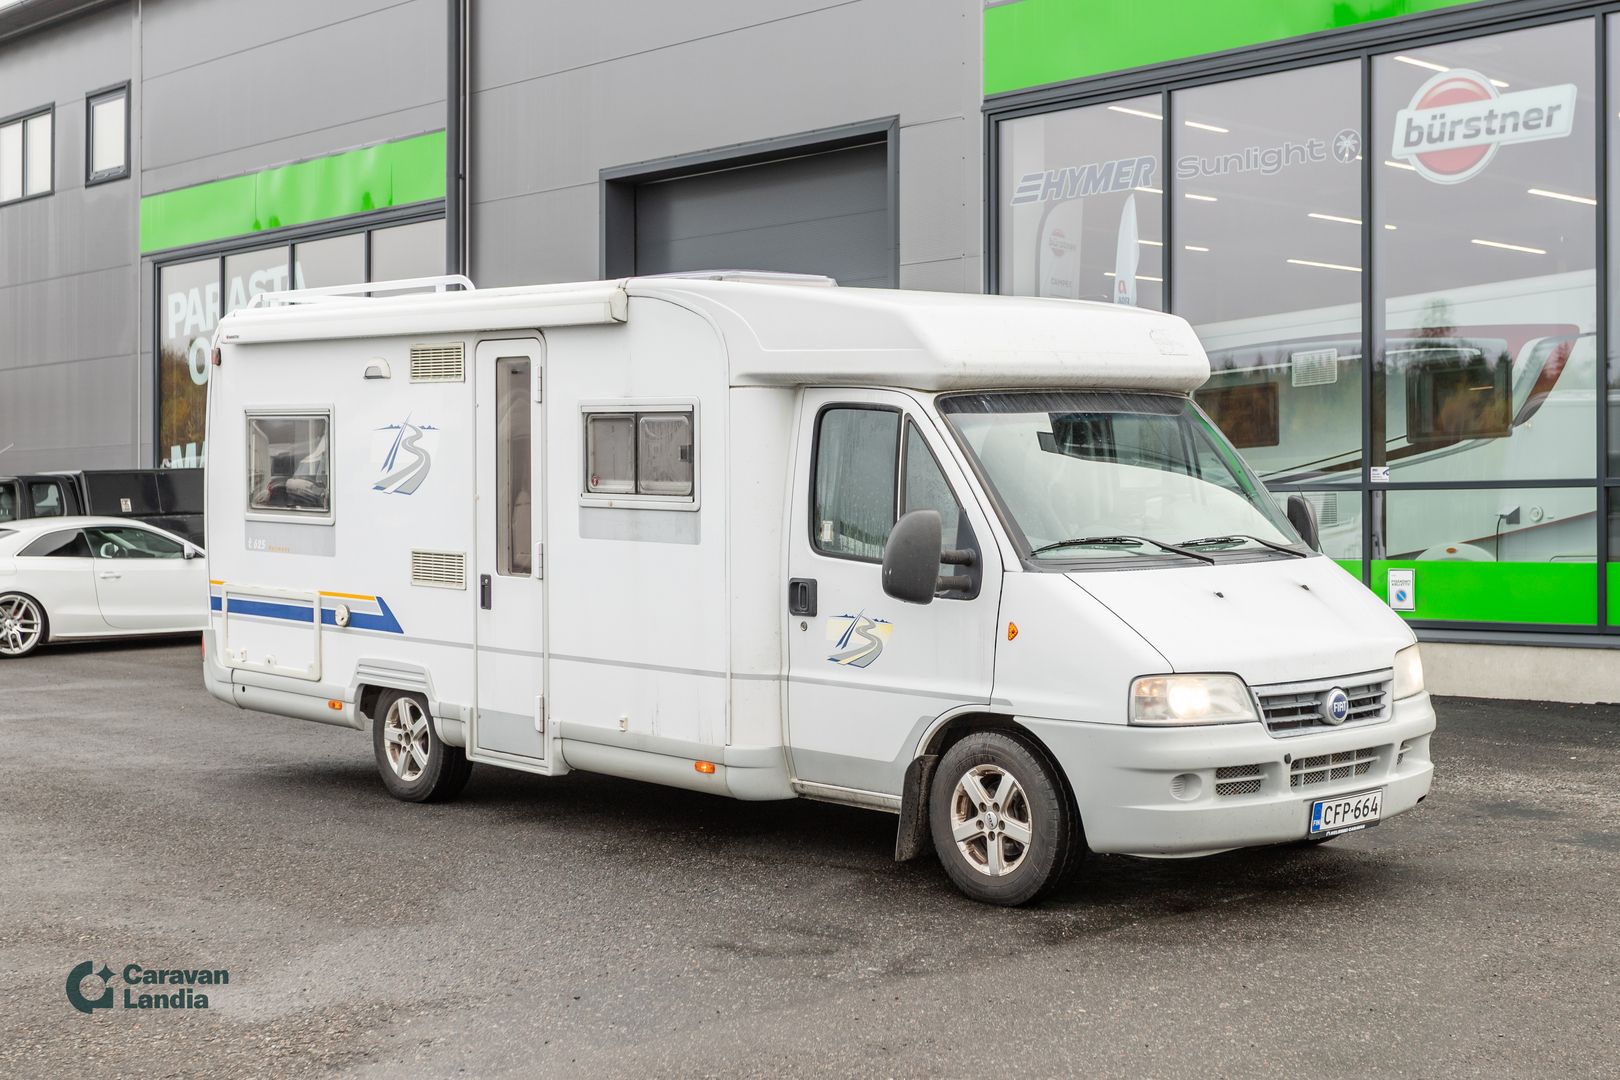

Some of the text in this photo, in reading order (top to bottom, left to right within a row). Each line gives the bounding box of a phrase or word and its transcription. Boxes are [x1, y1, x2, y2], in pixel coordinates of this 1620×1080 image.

[1404, 104, 1562, 148] bürstner
[1040, 155, 1157, 201] HYMER
[1177, 138, 1326, 180] Sunlight
[1333, 700, 1347, 712] FIAT
[1324, 796, 1378, 825] CFP-664
